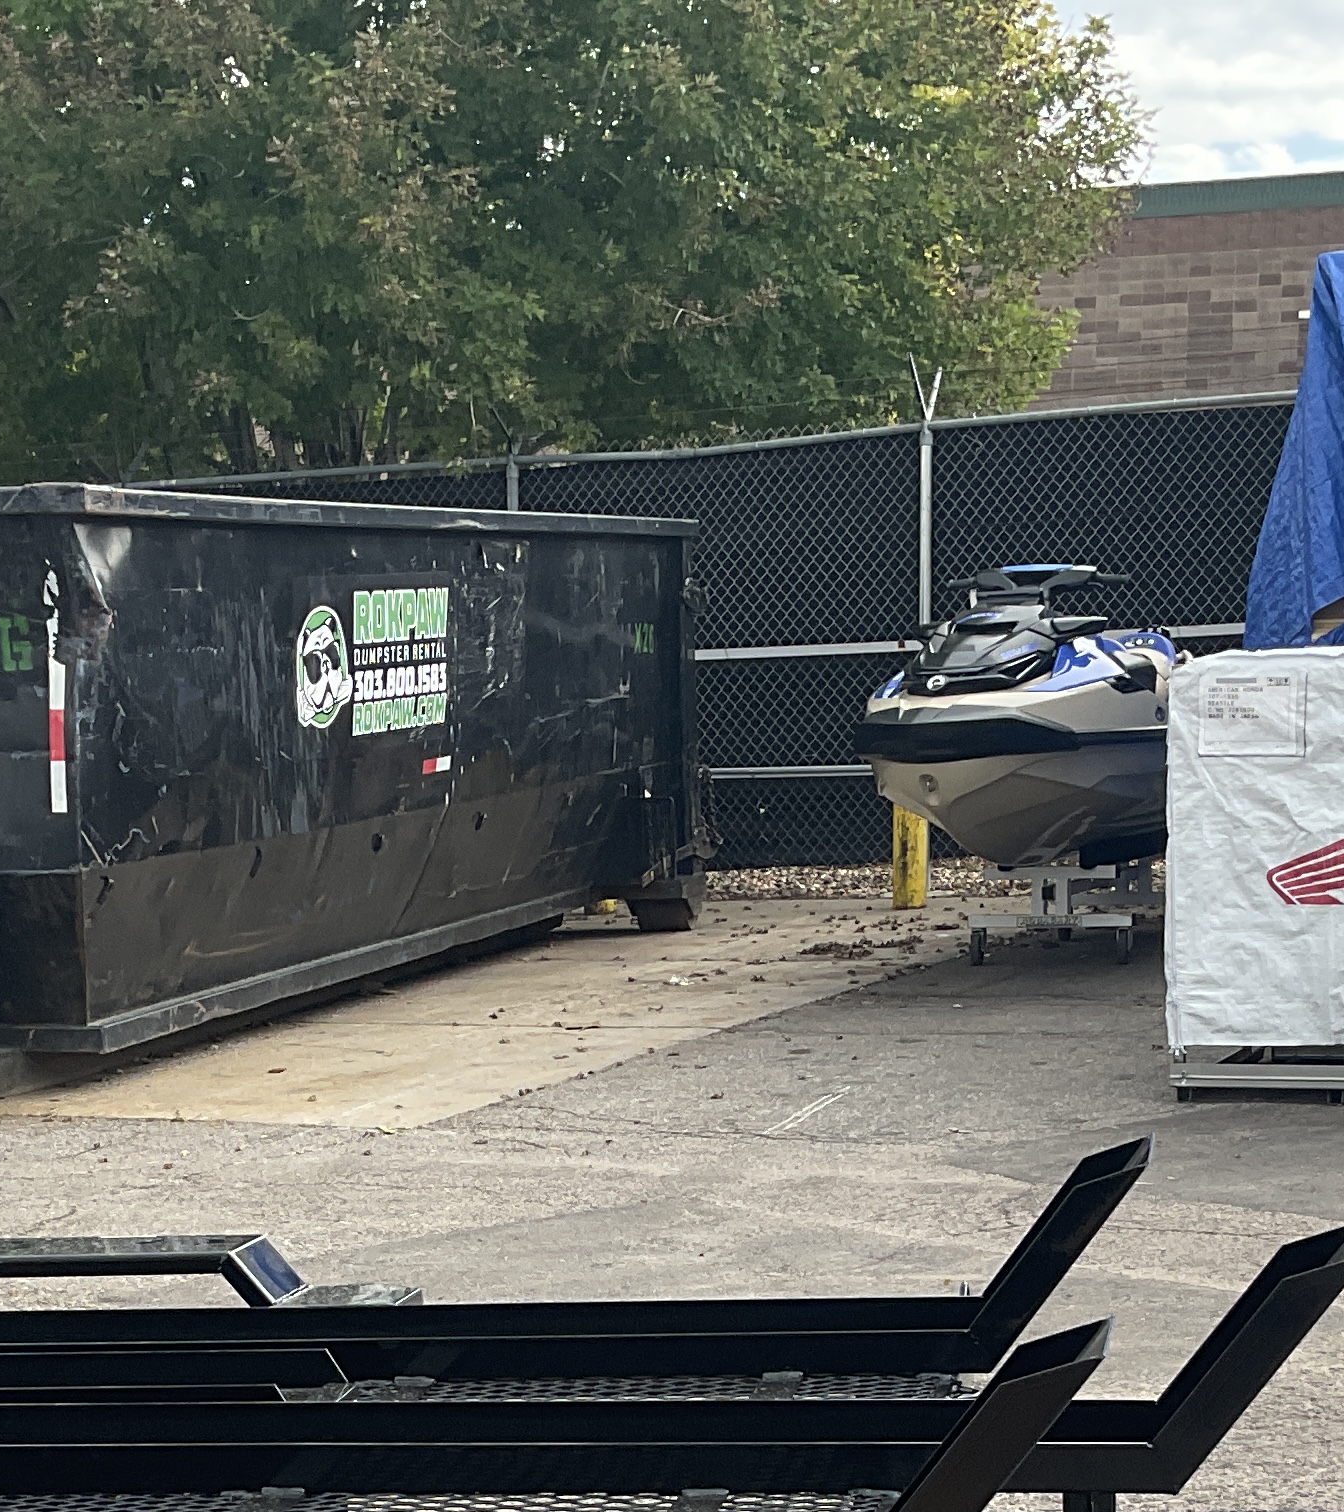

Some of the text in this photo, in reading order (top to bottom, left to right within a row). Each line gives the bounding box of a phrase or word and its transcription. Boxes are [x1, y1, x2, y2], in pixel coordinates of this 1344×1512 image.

[353, 587, 449, 644] ROKPAW
[353, 641, 447, 666] DUMPSTER RENTAL
[353, 662, 447, 701] 303.800.1583
[352, 693, 448, 737] ROKPAW.COM
